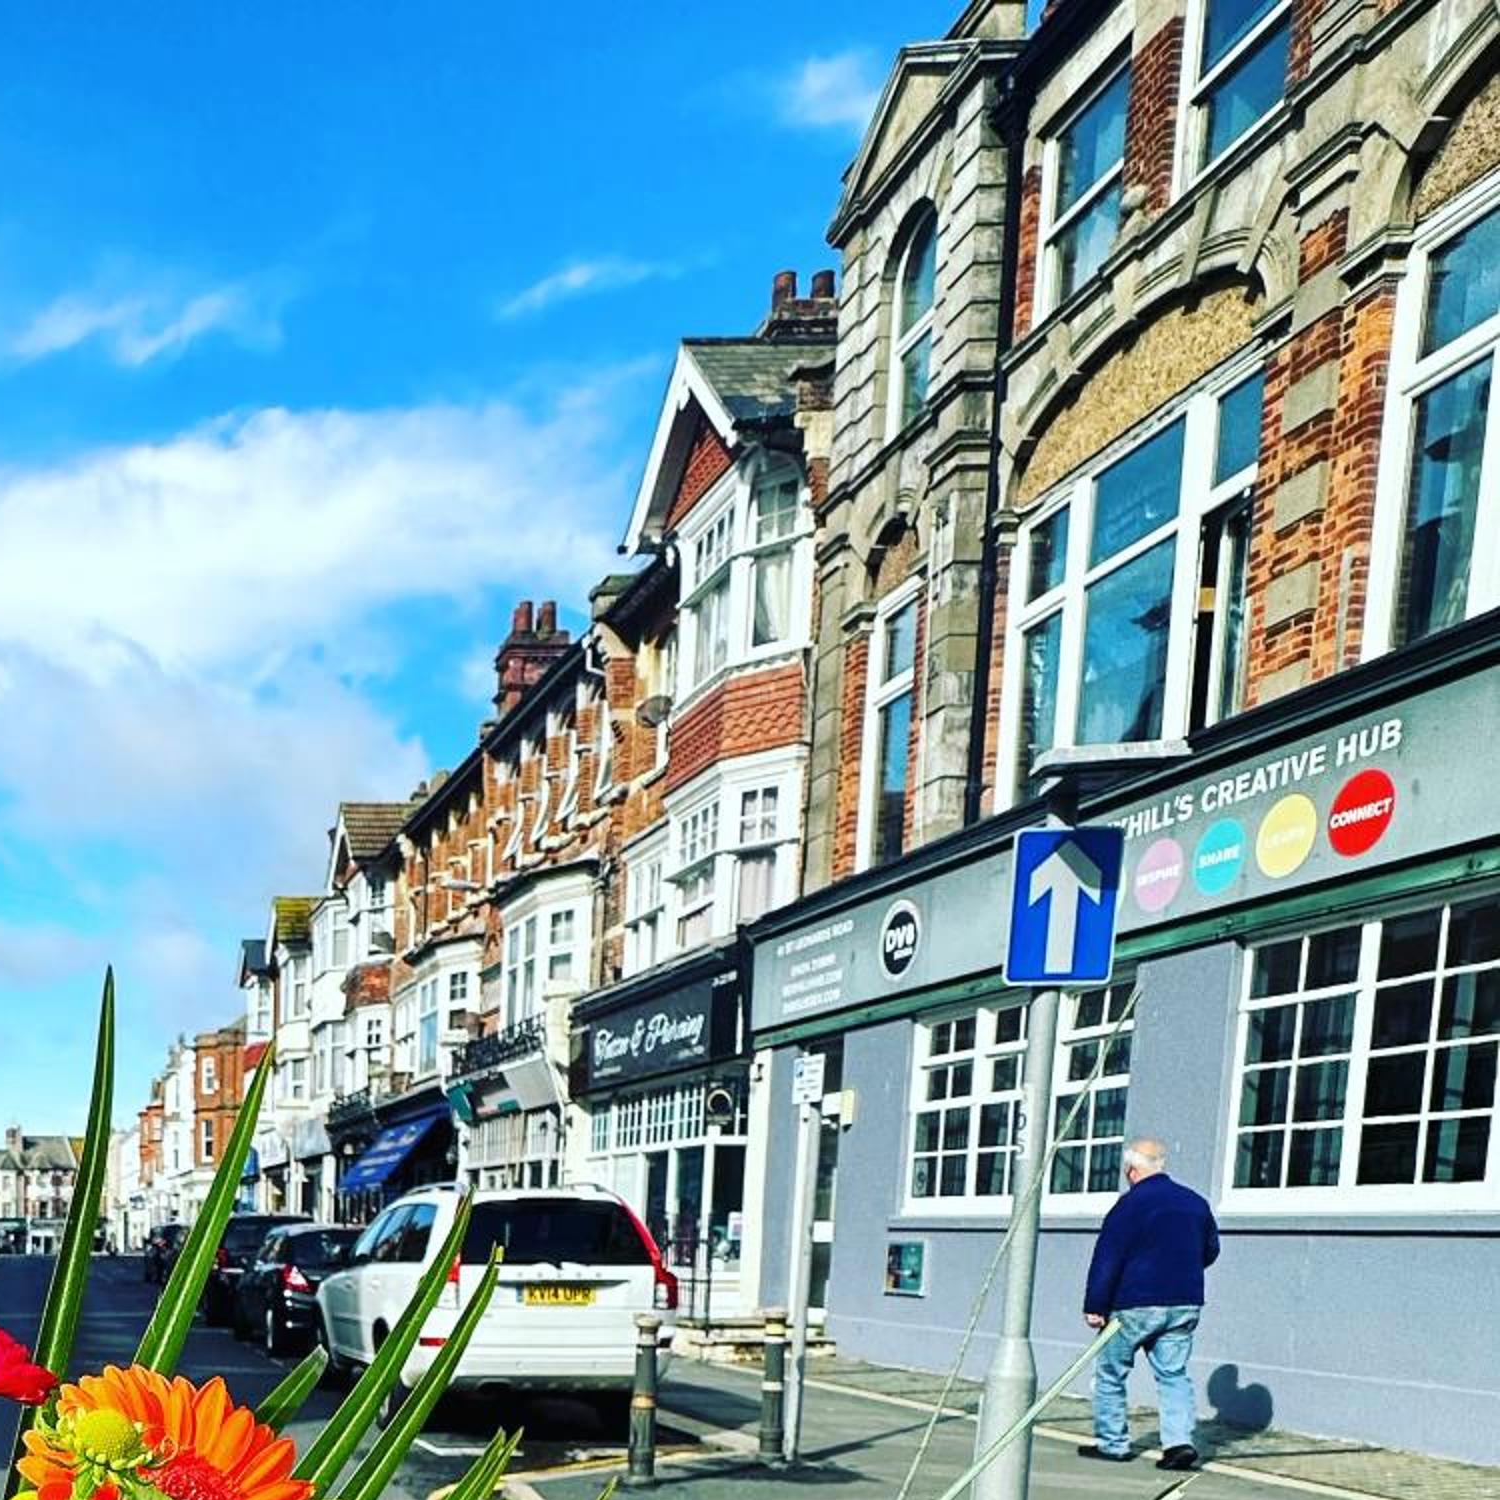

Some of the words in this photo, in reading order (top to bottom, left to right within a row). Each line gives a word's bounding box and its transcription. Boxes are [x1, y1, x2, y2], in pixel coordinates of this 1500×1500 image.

[1201, 745, 1326, 813] CREATIVE
[1336, 718, 1403, 767] HUB
[1329, 797, 1393, 829] CONNECT
[1199, 844, 1240, 868] SHARE
